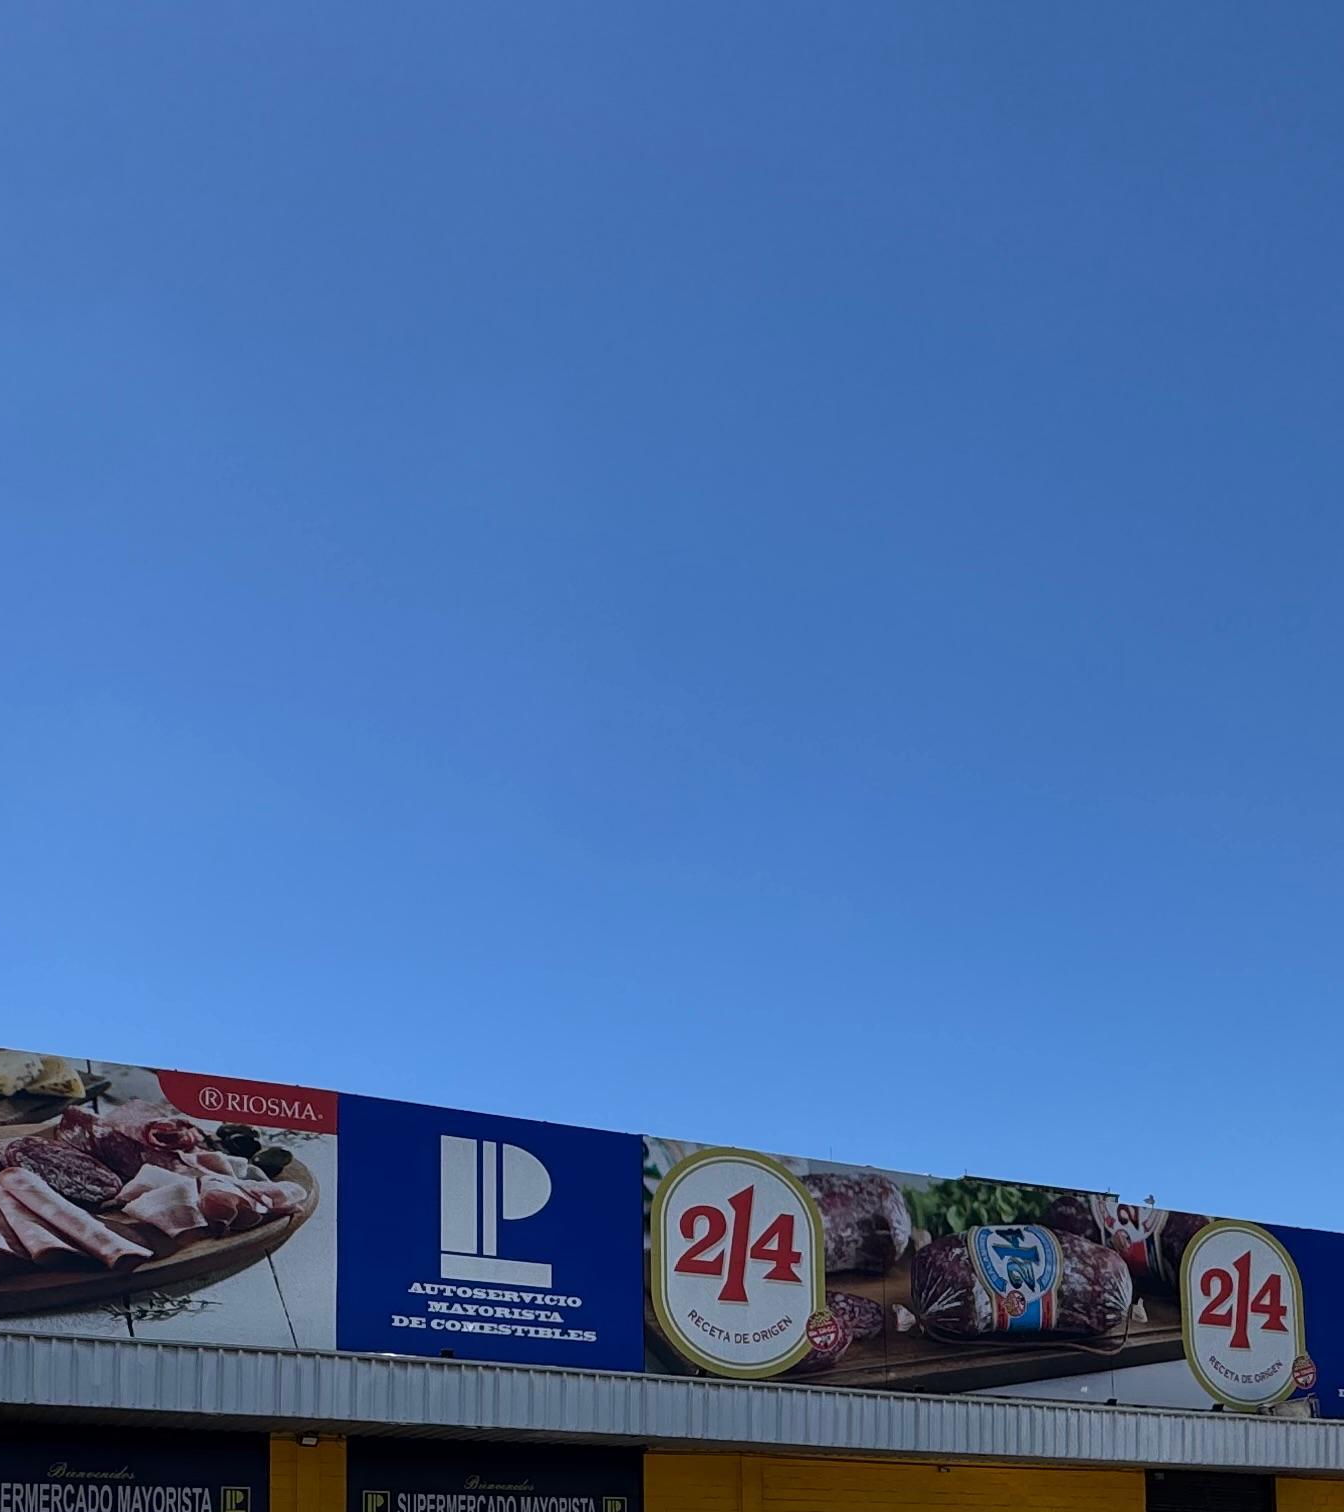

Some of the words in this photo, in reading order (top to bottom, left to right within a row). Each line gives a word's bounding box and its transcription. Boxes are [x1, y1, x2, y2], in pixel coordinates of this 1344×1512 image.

[408, 1282, 582, 1308] AUTOSERVICIO
[428, 1301, 564, 1323] MAYORISTA
[392, 1315, 426, 1328] DE
[430, 1319, 597, 1342] COMESTIBLES
[687, 1309, 730, 1342] RECETA
[734, 1333, 750, 1344] DE
[752, 1315, 793, 1343] ORIGEN
[1209, 1355, 1240, 1382] RECETA
[1242, 1374, 1254, 1384] DE
[1254, 1361, 1283, 1383] ORIGEN
